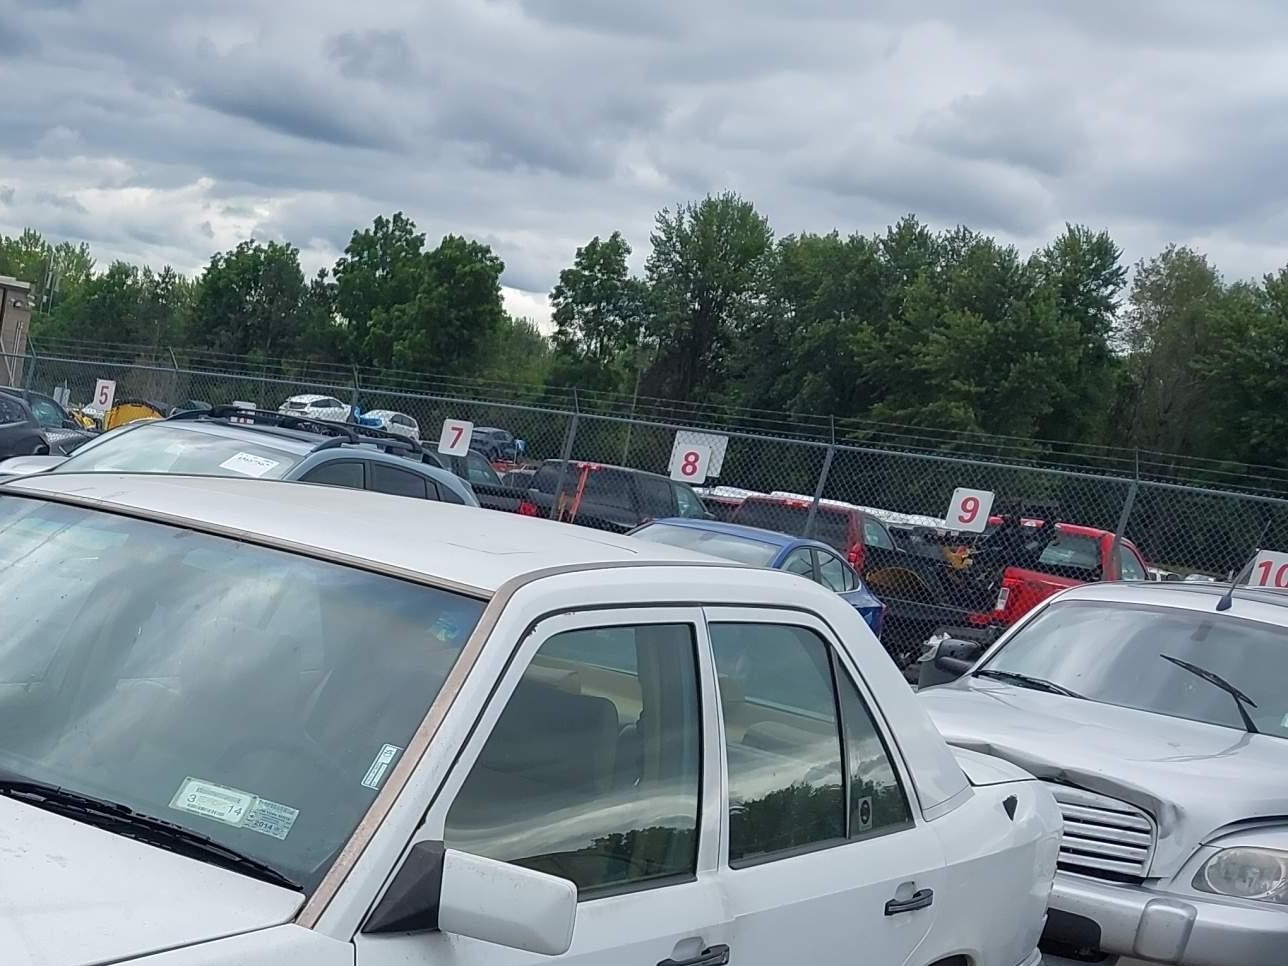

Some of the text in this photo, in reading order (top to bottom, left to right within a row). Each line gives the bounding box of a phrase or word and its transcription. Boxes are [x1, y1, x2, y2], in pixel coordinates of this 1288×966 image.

[98, 385, 110, 405] 5
[449, 426, 464, 448] 7
[681, 451, 700, 476] 8
[958, 496, 980, 524] 9
[186, 793, 197, 803] 3
[227, 804, 243, 817] 14
[253, 821, 274, 831] 2014
